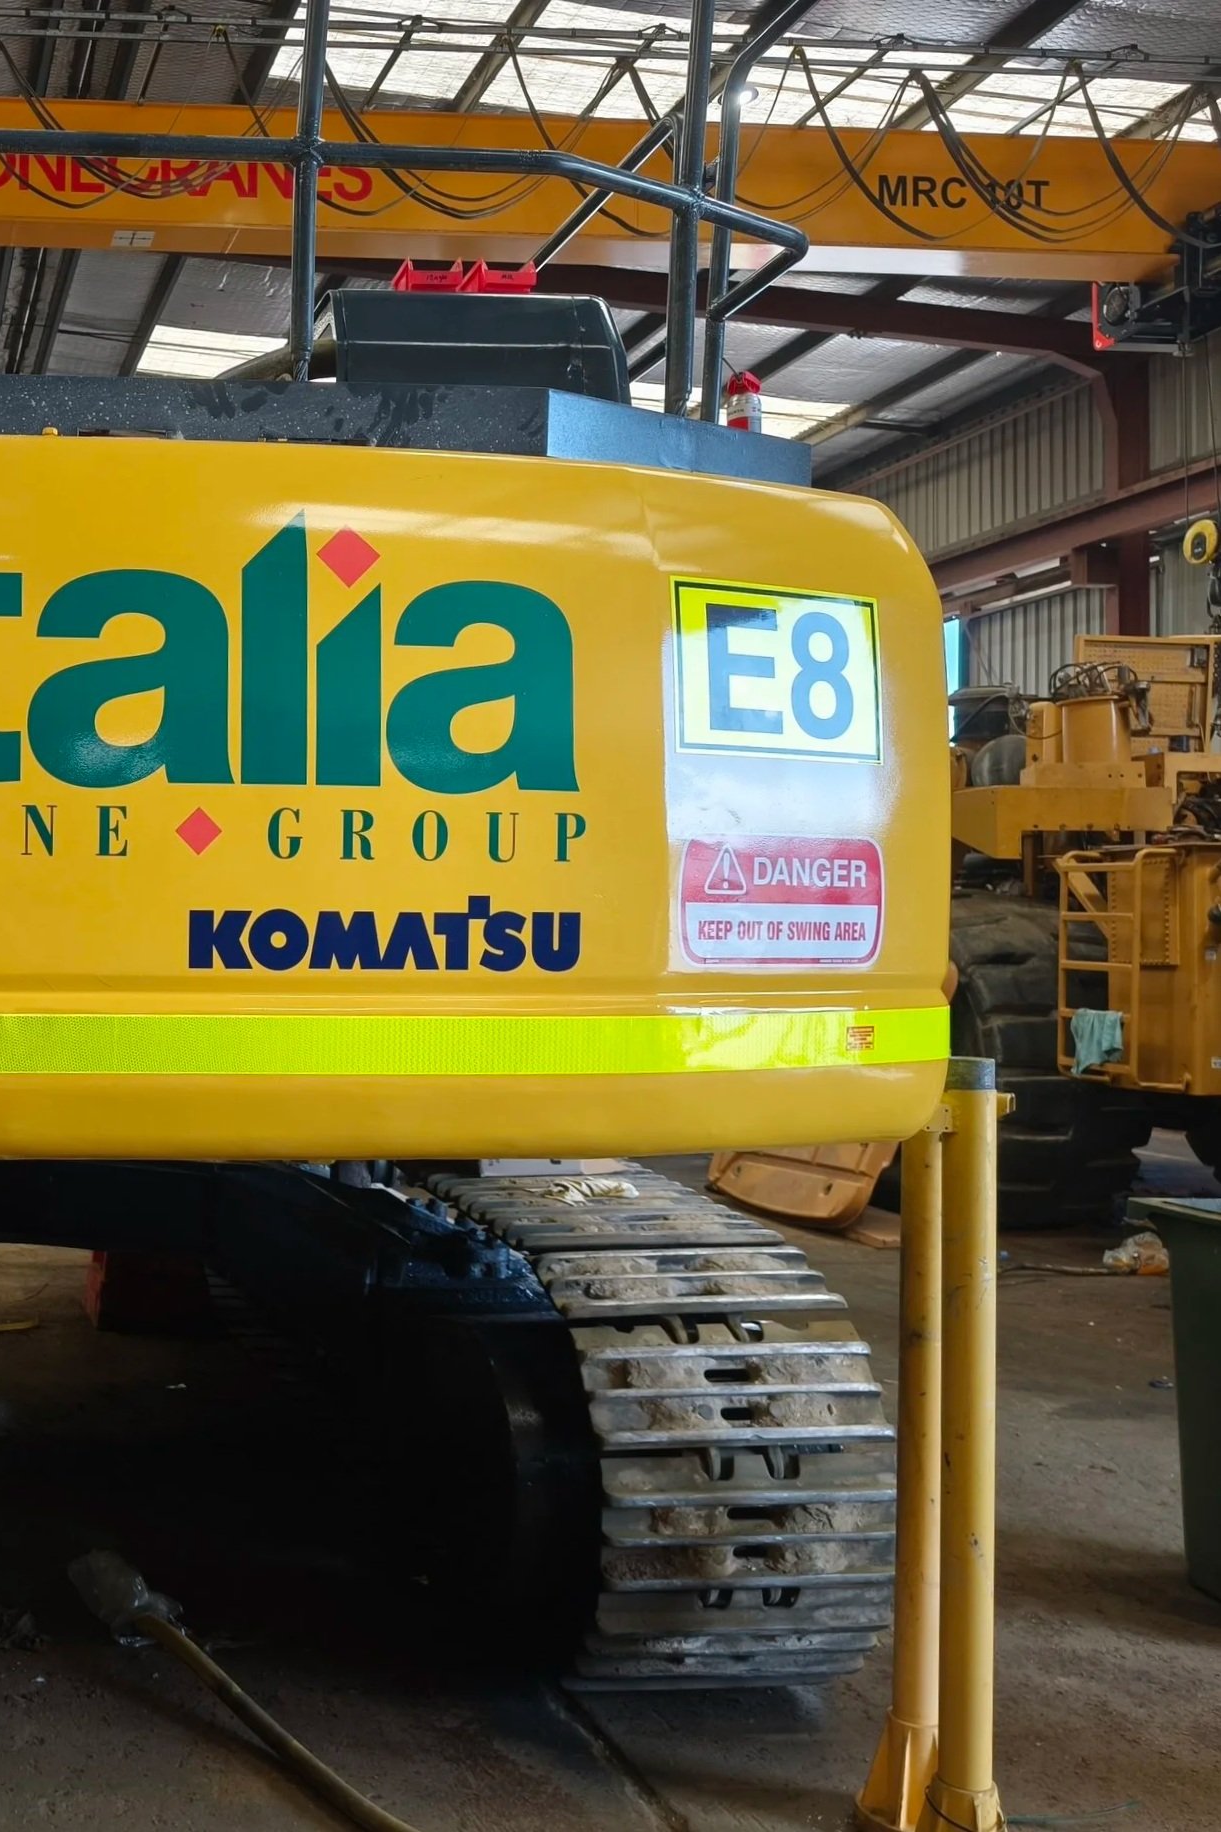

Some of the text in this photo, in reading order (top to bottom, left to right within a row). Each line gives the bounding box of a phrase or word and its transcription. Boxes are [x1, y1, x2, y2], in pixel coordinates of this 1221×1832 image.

[878, 175, 1050, 210] MRC 10T
[705, 603, 854, 740] E8
[267, 807, 587, 863] GROUP
[753, 857, 867, 887] DANGER
[188, 895, 582, 972] KOMATSU
[698, 920, 866, 941] KEEP OUT OF SWING AREA
